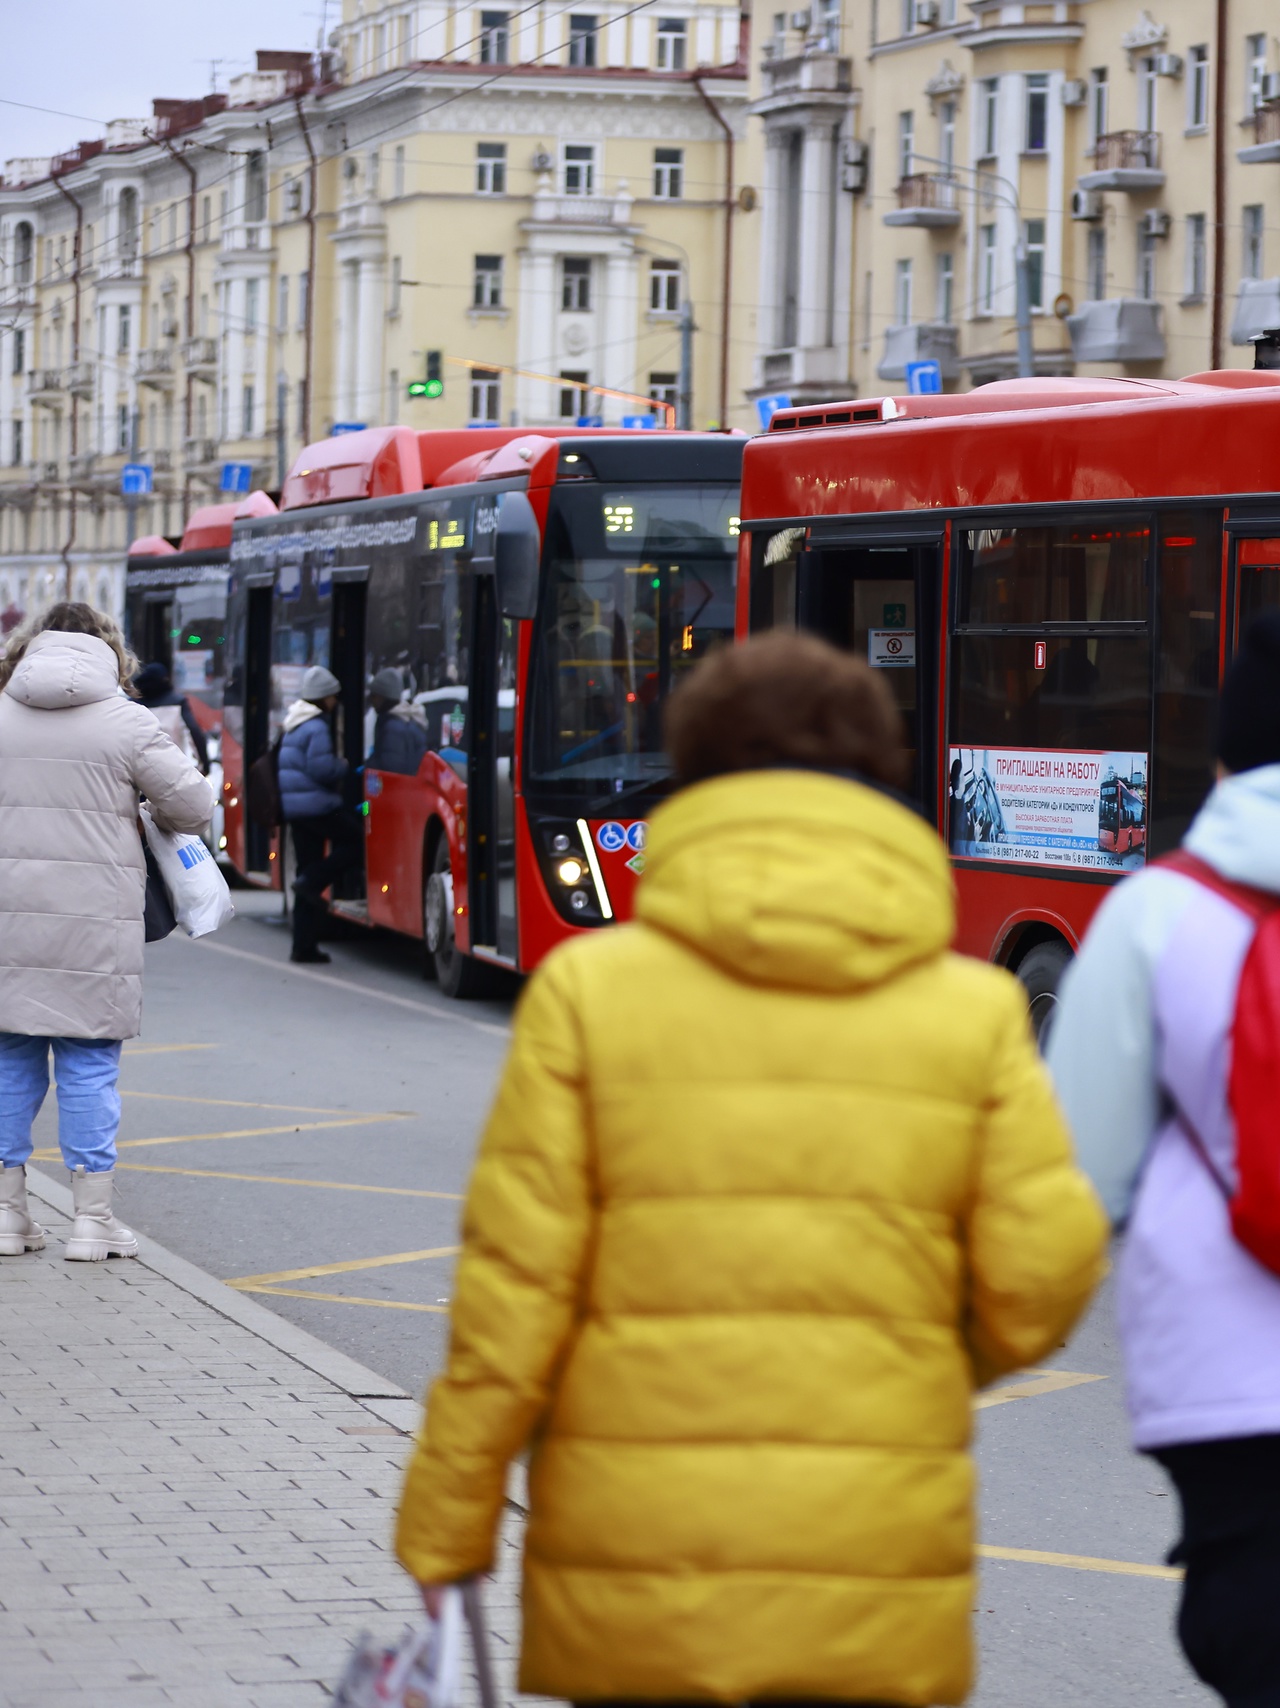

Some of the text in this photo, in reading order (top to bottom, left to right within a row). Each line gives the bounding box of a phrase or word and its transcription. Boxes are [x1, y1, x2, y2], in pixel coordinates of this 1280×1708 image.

[996, 759, 1100, 780] ПРИГЛАШАЕМ НА РАБОТУ
[1000, 783, 1039, 794] МУНИЦИПАЛЬНОЕ
[1040, 785, 1065, 795] УНИТАРНОЕ
[1067, 787, 1100, 797] ПРЕДПРИЯТИЕ
[1001, 798, 1025, 808] ВОДИТЕЛЕЙ
[1026, 800, 1050, 810] КАТЕГОРИИ
[1063, 803, 1094, 812] КОНДУКТОРОВ
[1016, 813, 1034, 822] ВЫСОКАЯ
[1035, 815, 1060, 824] ЗАРАБОТНАЯ
[1002, 847, 1014, 858] (987)
[1015, 849, 1039, 859] 217-00-22
[1077, 854, 1081, 863] 8
[1082, 854, 1095, 866] (987)
[1097, 856, 1123, 866] 217-00-44
